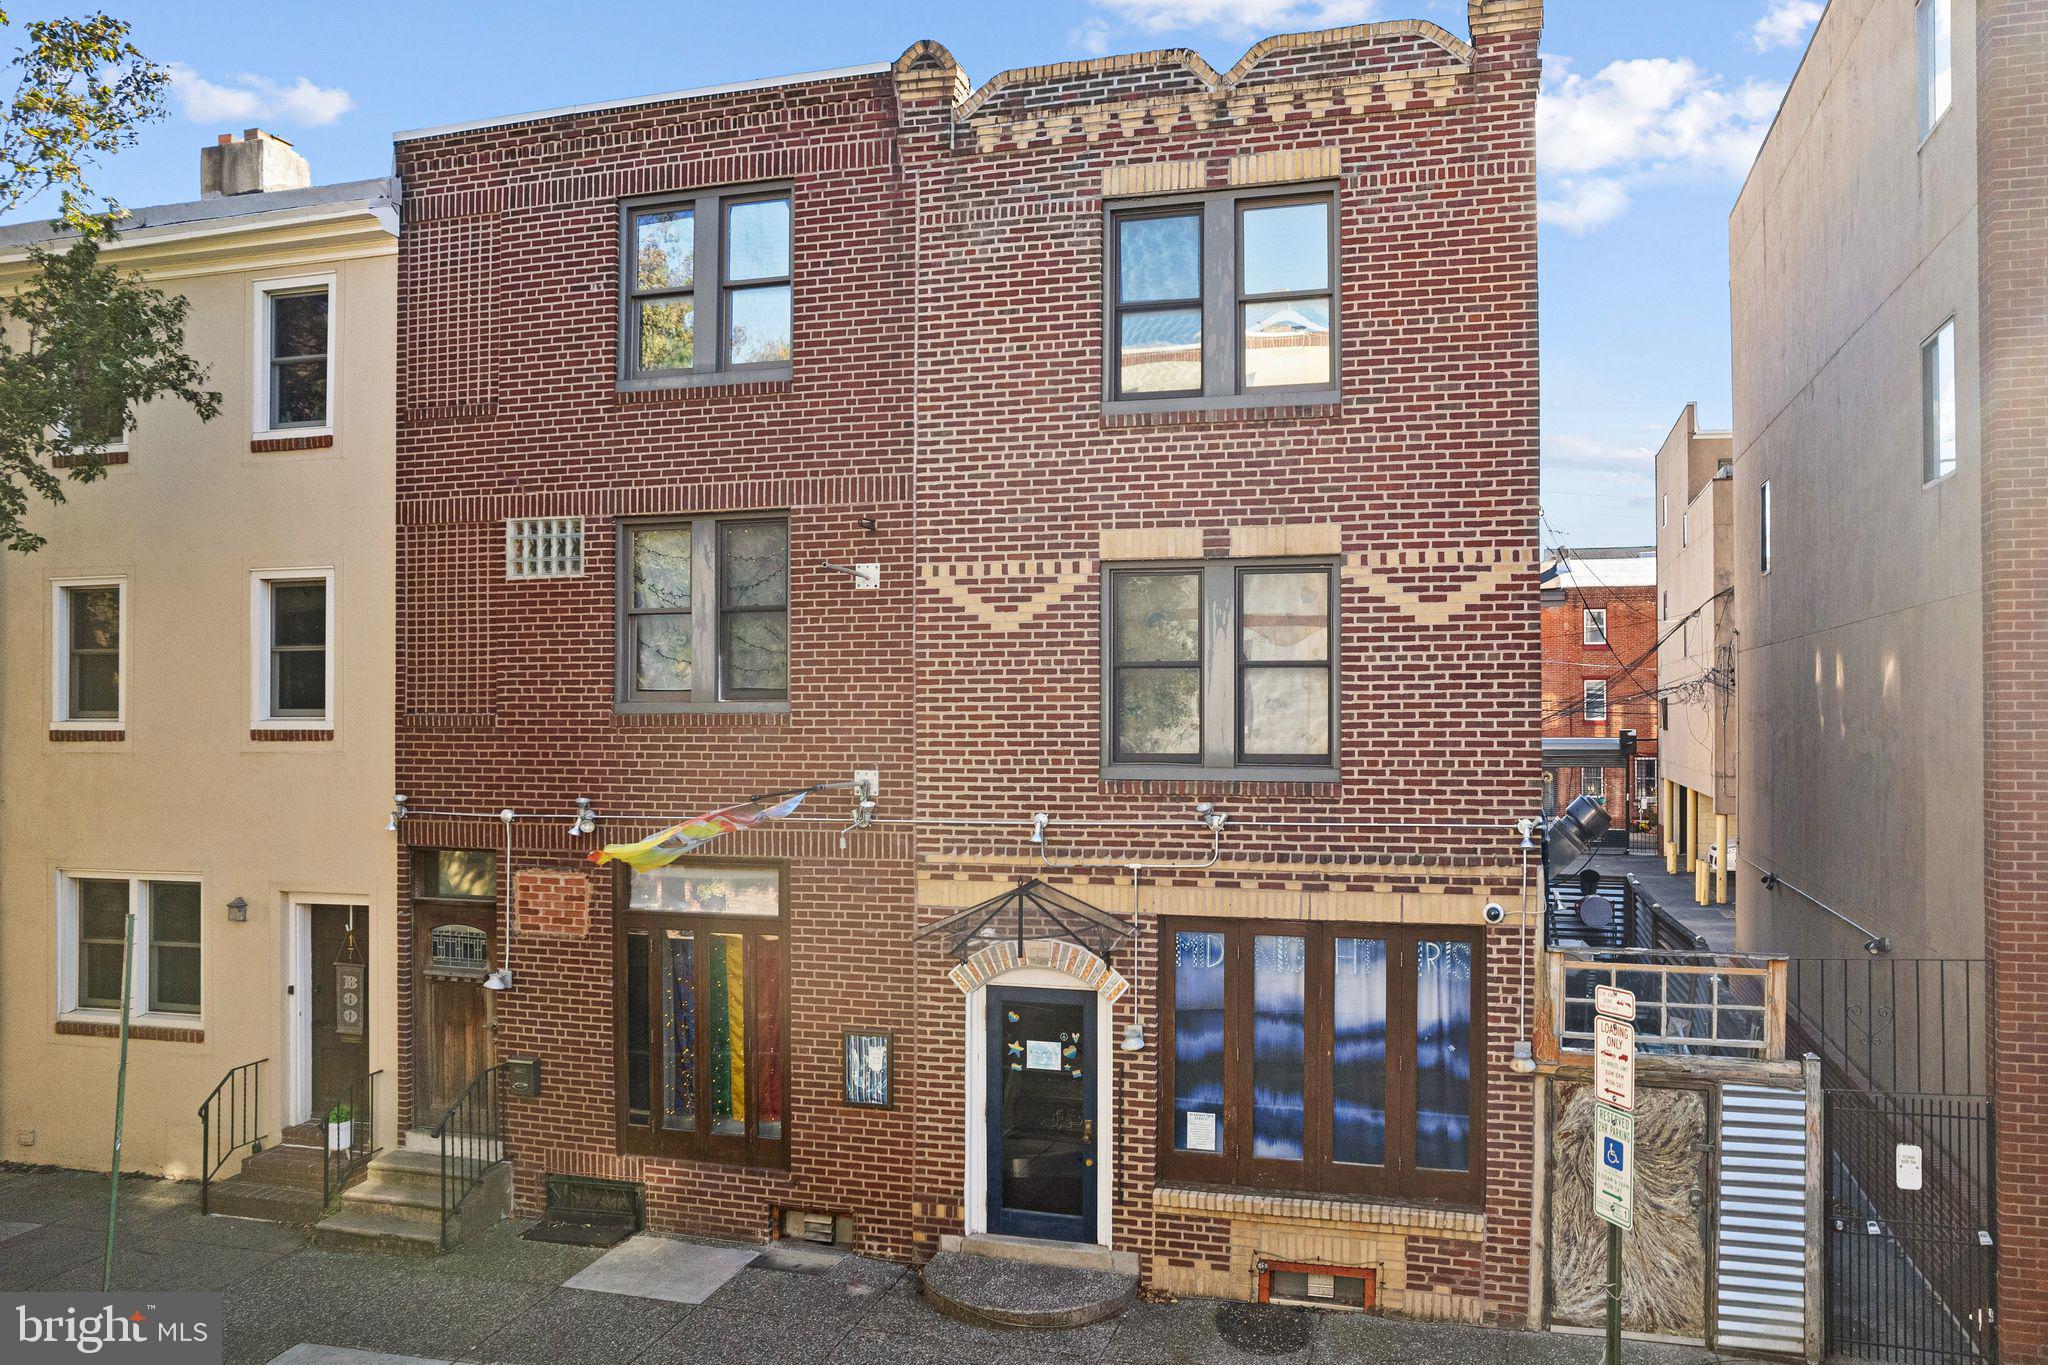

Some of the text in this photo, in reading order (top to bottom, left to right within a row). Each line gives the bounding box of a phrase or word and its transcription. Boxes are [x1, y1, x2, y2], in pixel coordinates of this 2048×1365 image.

[1600, 1022, 1629, 1040] LOADING
[1606, 1036, 1623, 1051] ONLY
[1600, 1109, 1630, 1130] RESERVED
[1610, 1125, 1630, 1144] PARKING
